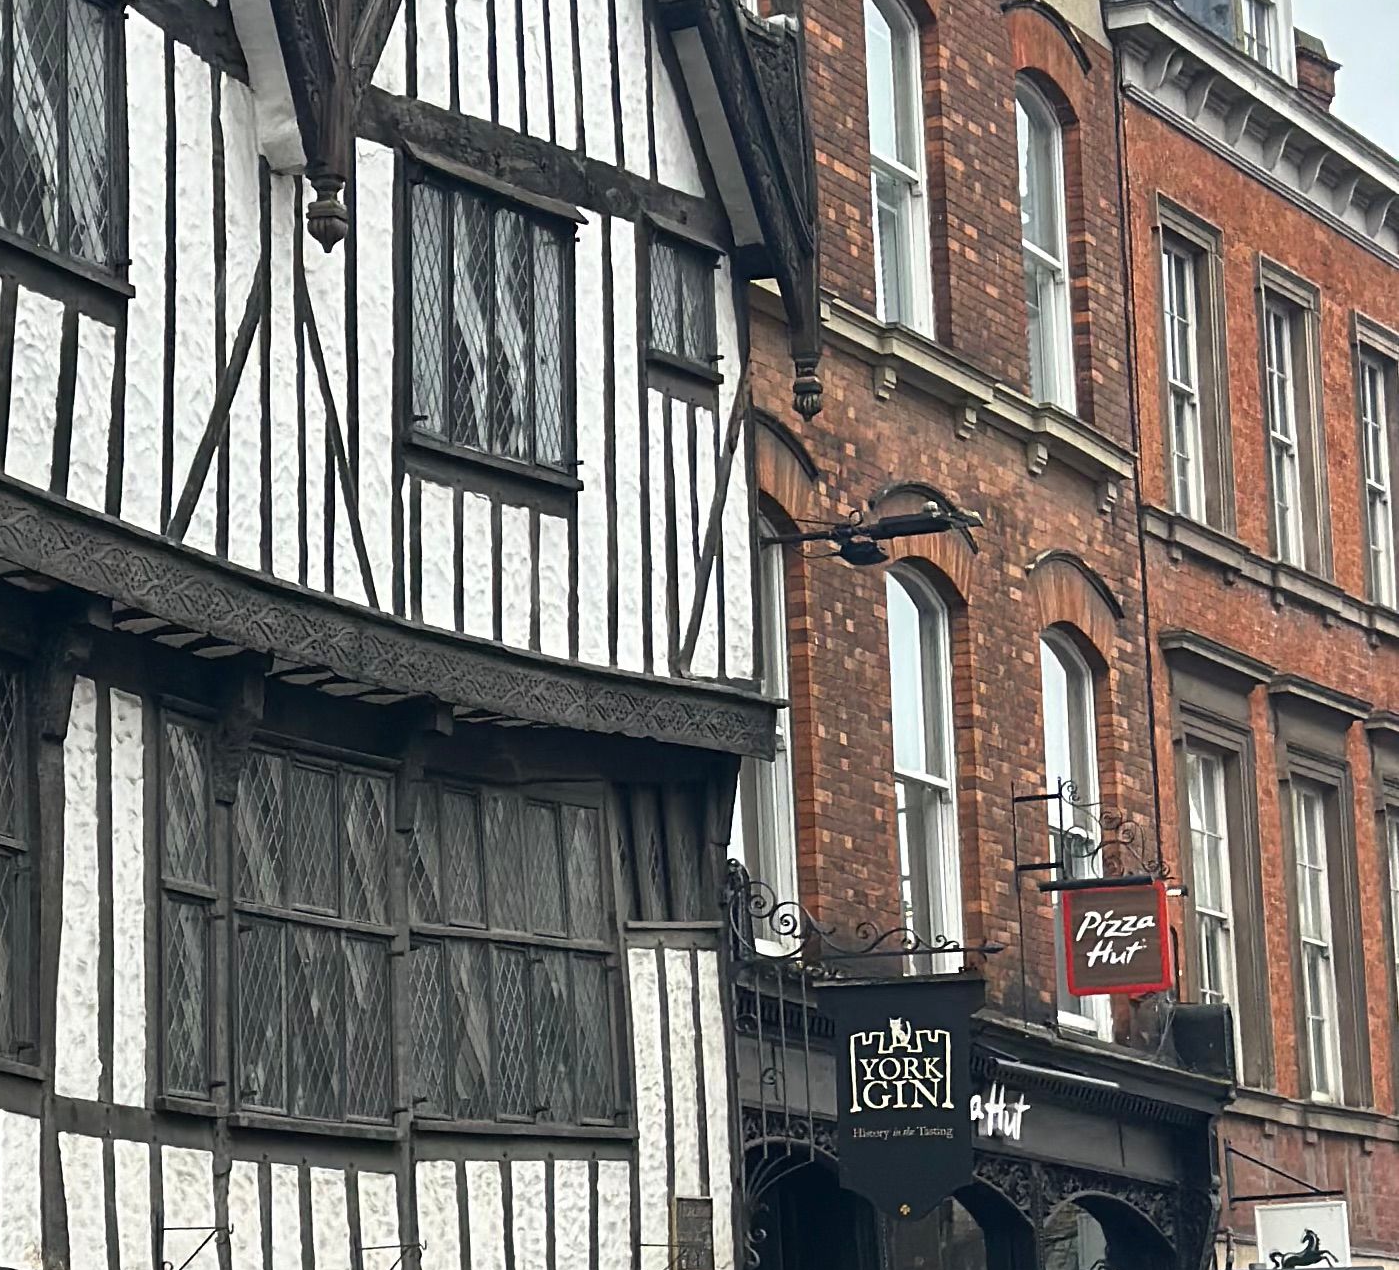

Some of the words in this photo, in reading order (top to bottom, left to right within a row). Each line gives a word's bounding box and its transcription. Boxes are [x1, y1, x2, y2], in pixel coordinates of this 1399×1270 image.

[1076, 910, 1156, 942] Pizza
[1086, 939, 1143, 968] Hut
[860, 1057, 943, 1081] YORK
[863, 1078, 941, 1109] GIN
[985, 1081, 1031, 1140] Hut
[853, 1127, 890, 1140] History
[916, 1126, 954, 1139] Tasting
